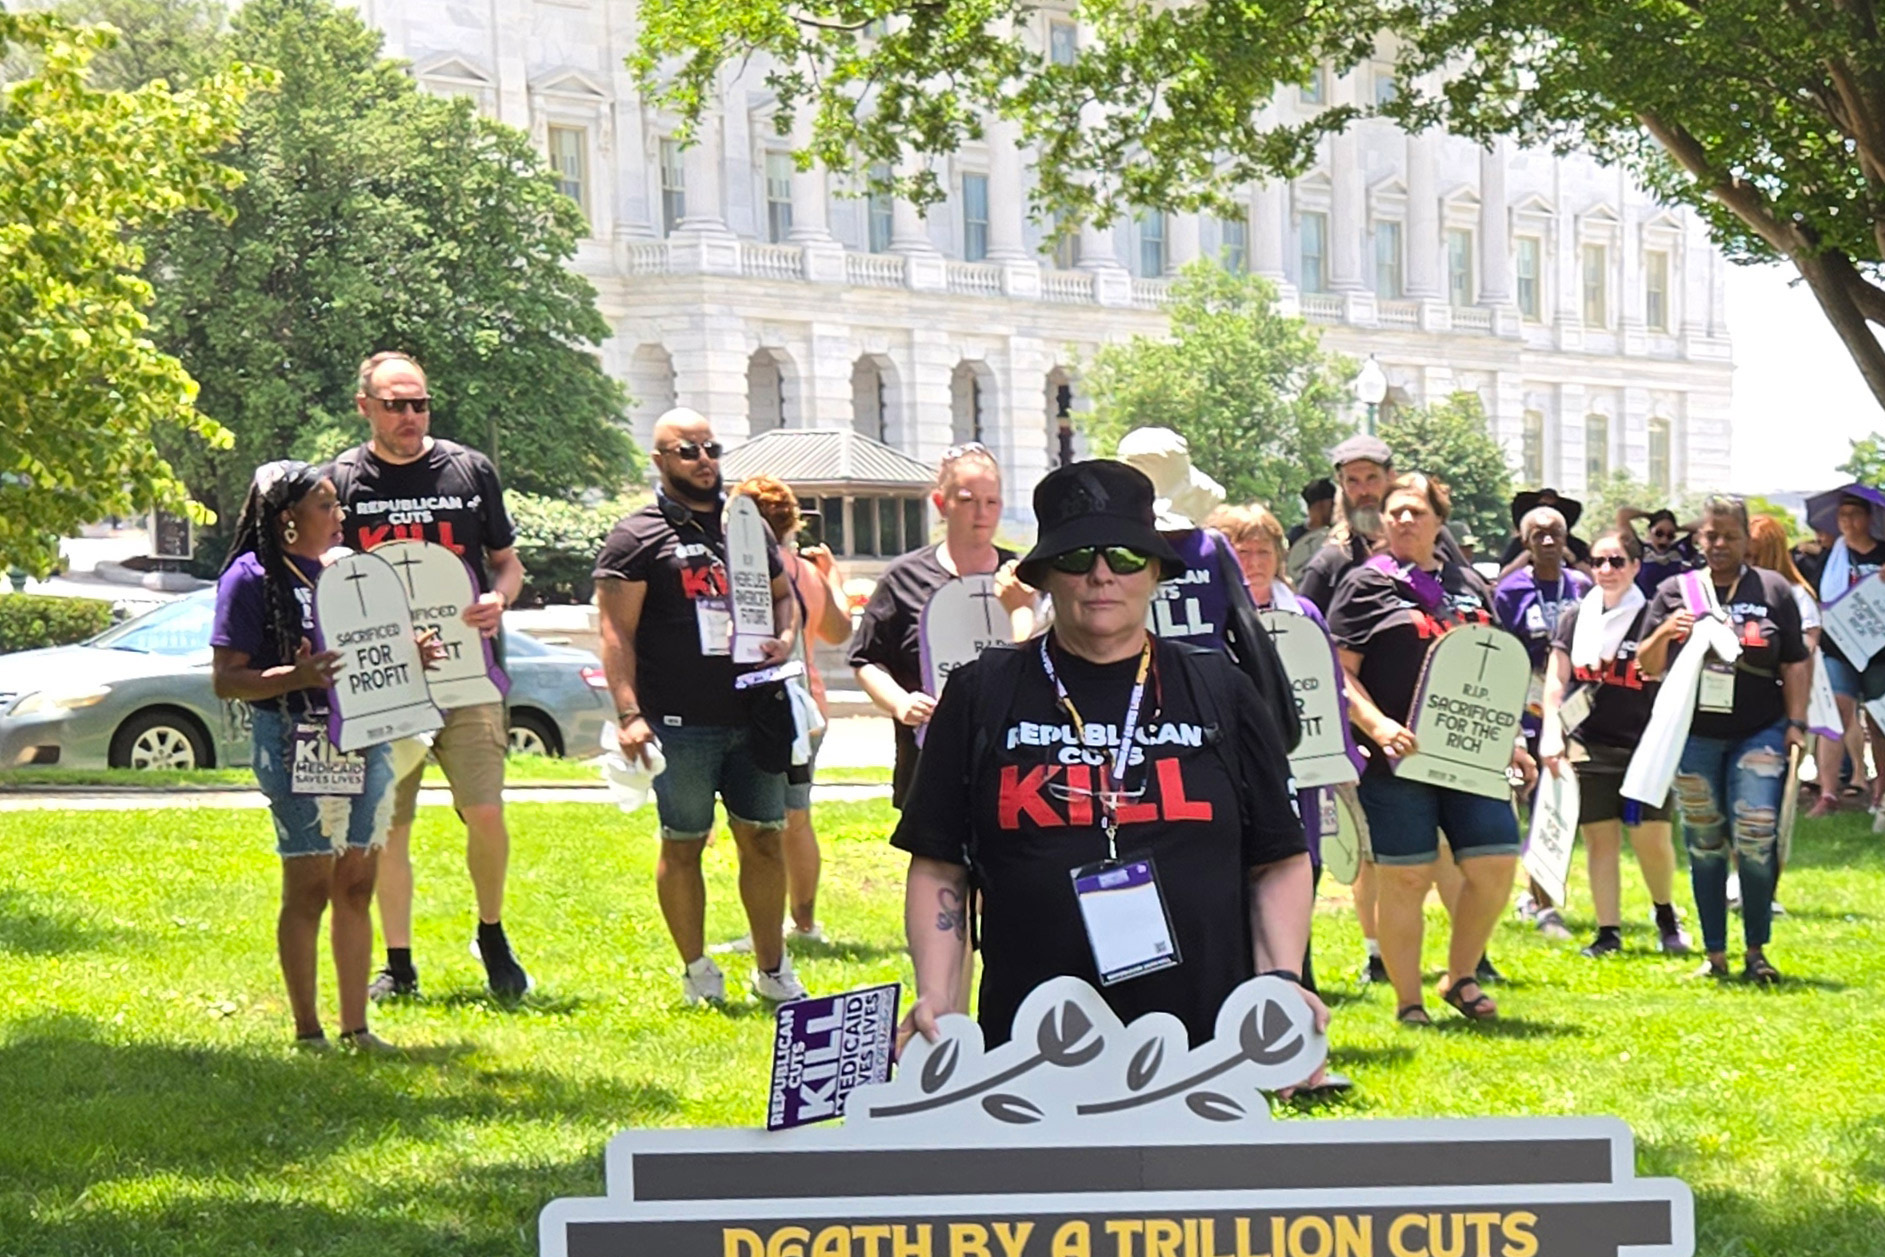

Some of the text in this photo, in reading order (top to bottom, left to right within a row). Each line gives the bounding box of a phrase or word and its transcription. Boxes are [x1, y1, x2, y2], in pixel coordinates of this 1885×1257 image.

[356, 496, 463, 515] REPUBLICAN
[388, 510, 434, 525] CUTS
[680, 565, 729, 599] KI
[410, 604, 457, 621] IFICED
[1146, 598, 1214, 637] ILL
[336, 623, 400, 647] SACRIFICED
[356, 644, 393, 670] FOR
[350, 663, 410, 695] PROFIT
[1427, 694, 1515, 728] SACRIFICED
[1435, 712, 1502, 741] FOR THE
[1007, 721, 1203, 750] REPUBLCAN
[1447, 735, 1482, 754] RICH
[296, 762, 363, 775] MEDICAID
[998, 757, 1213, 830] KILL
[837, 996, 863, 1112] MEDICAID
[857, 992, 879, 1086] VES LIVES
[770, 1009, 795, 1126] REPUBLICAN
[788, 1041, 806, 1089] CUTS
[798, 997, 845, 1120] KILL
